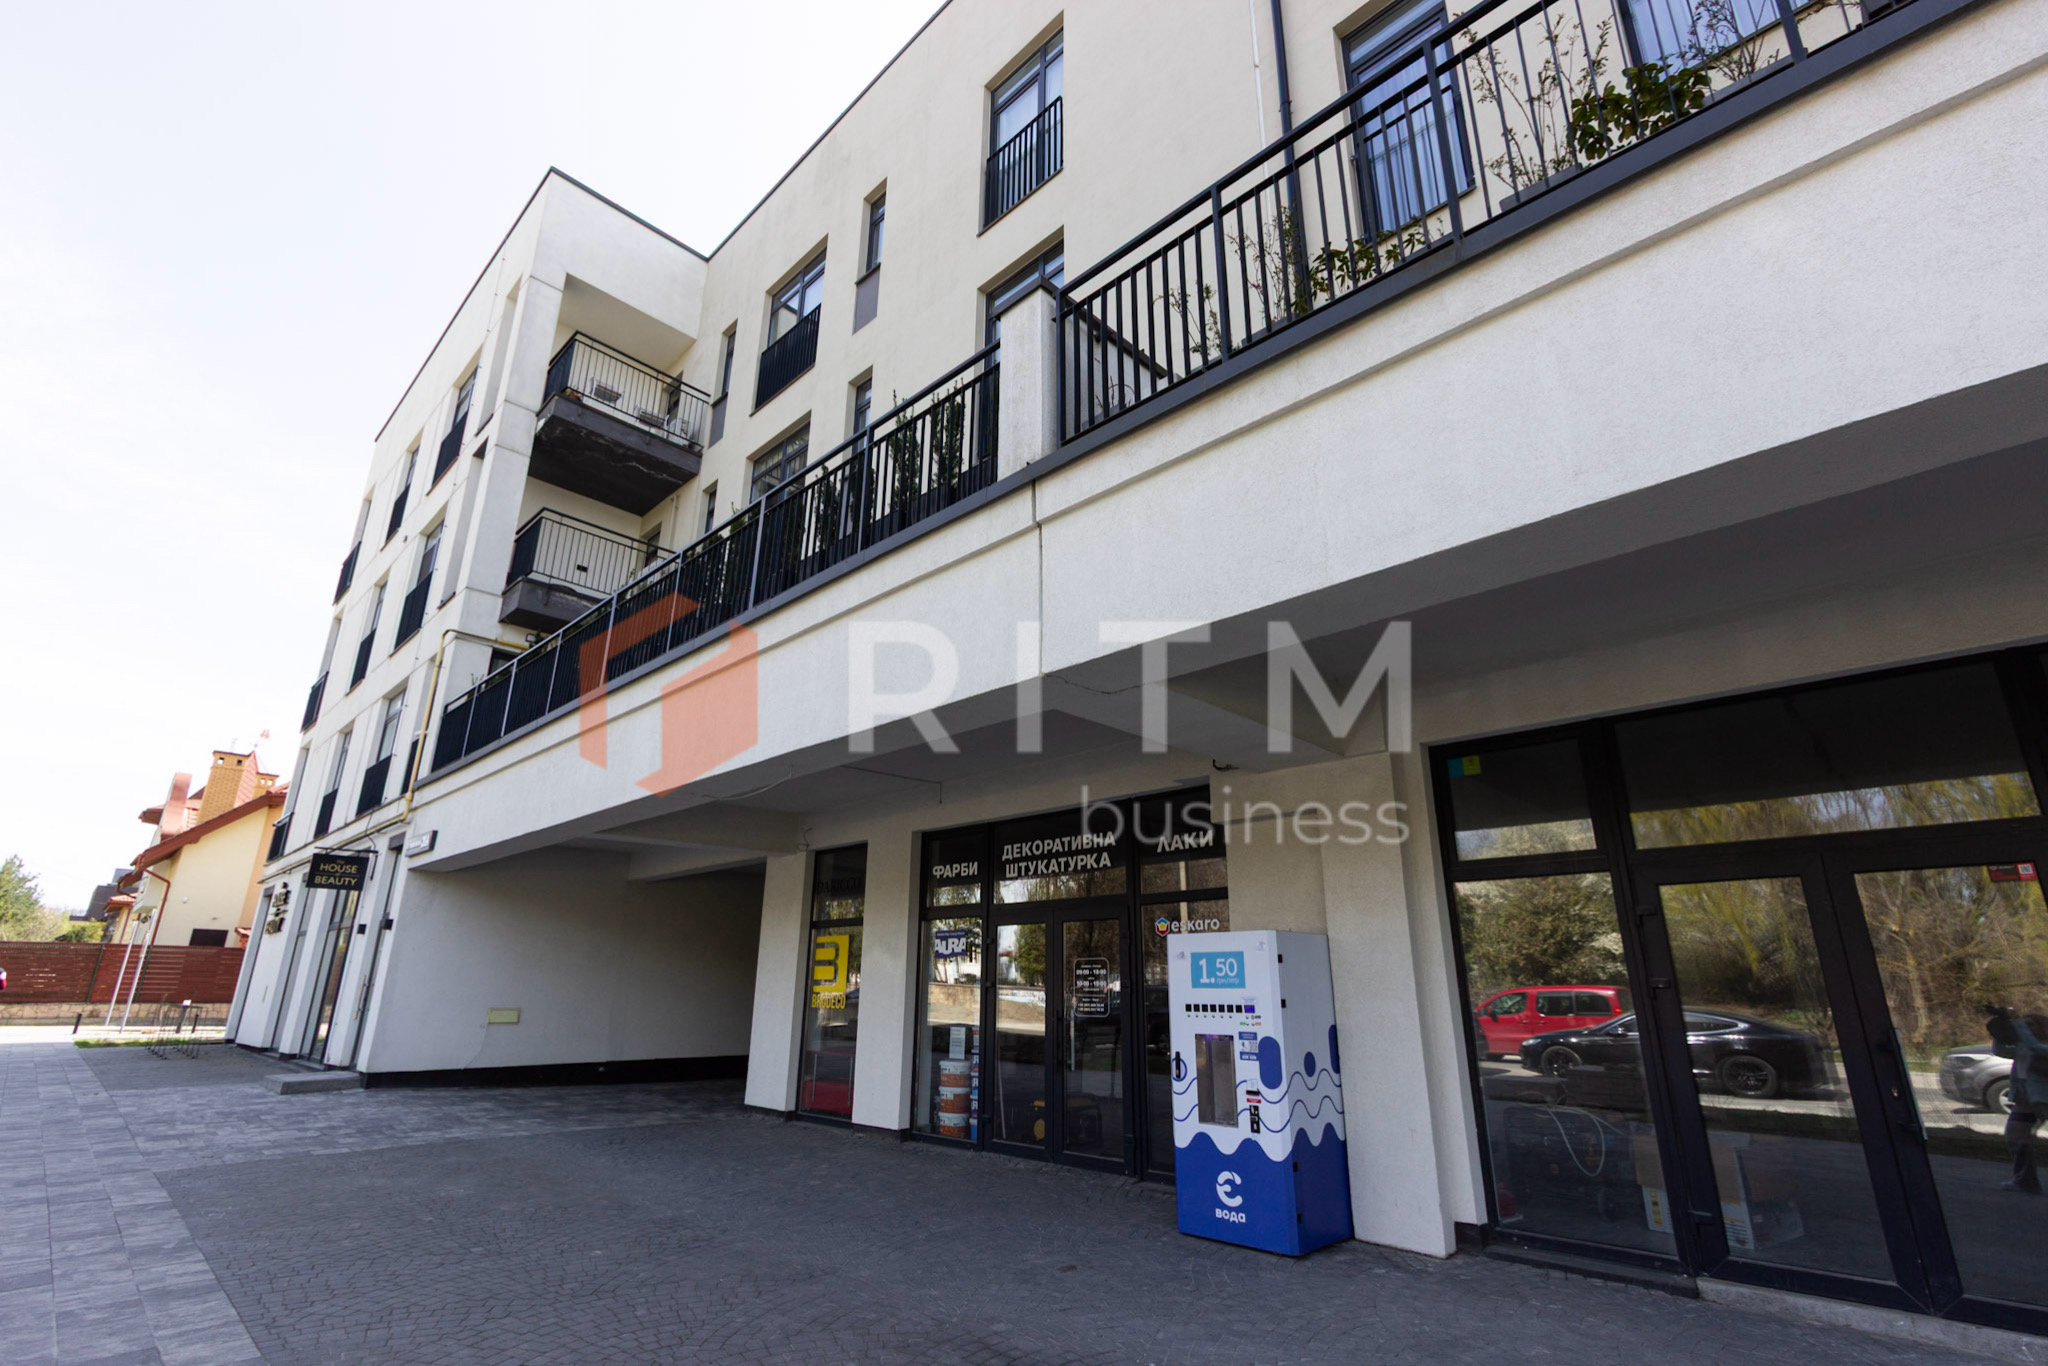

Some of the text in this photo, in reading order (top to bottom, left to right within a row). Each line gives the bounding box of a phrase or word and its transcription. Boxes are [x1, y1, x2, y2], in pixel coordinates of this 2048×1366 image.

[1002, 831, 1116, 861] ДЕКОРАТИВНА
[1157, 829, 1214, 853] ЛАКИ
[320, 863, 358, 874] HOUSE
[932, 861, 979, 879] ФАРБИ
[1005, 852, 1112, 878] ШТУКАТУРКА
[314, 876, 358, 886] BEAUTY
[1171, 918, 1220, 931] eskaro
[935, 937, 967, 955] AURA
